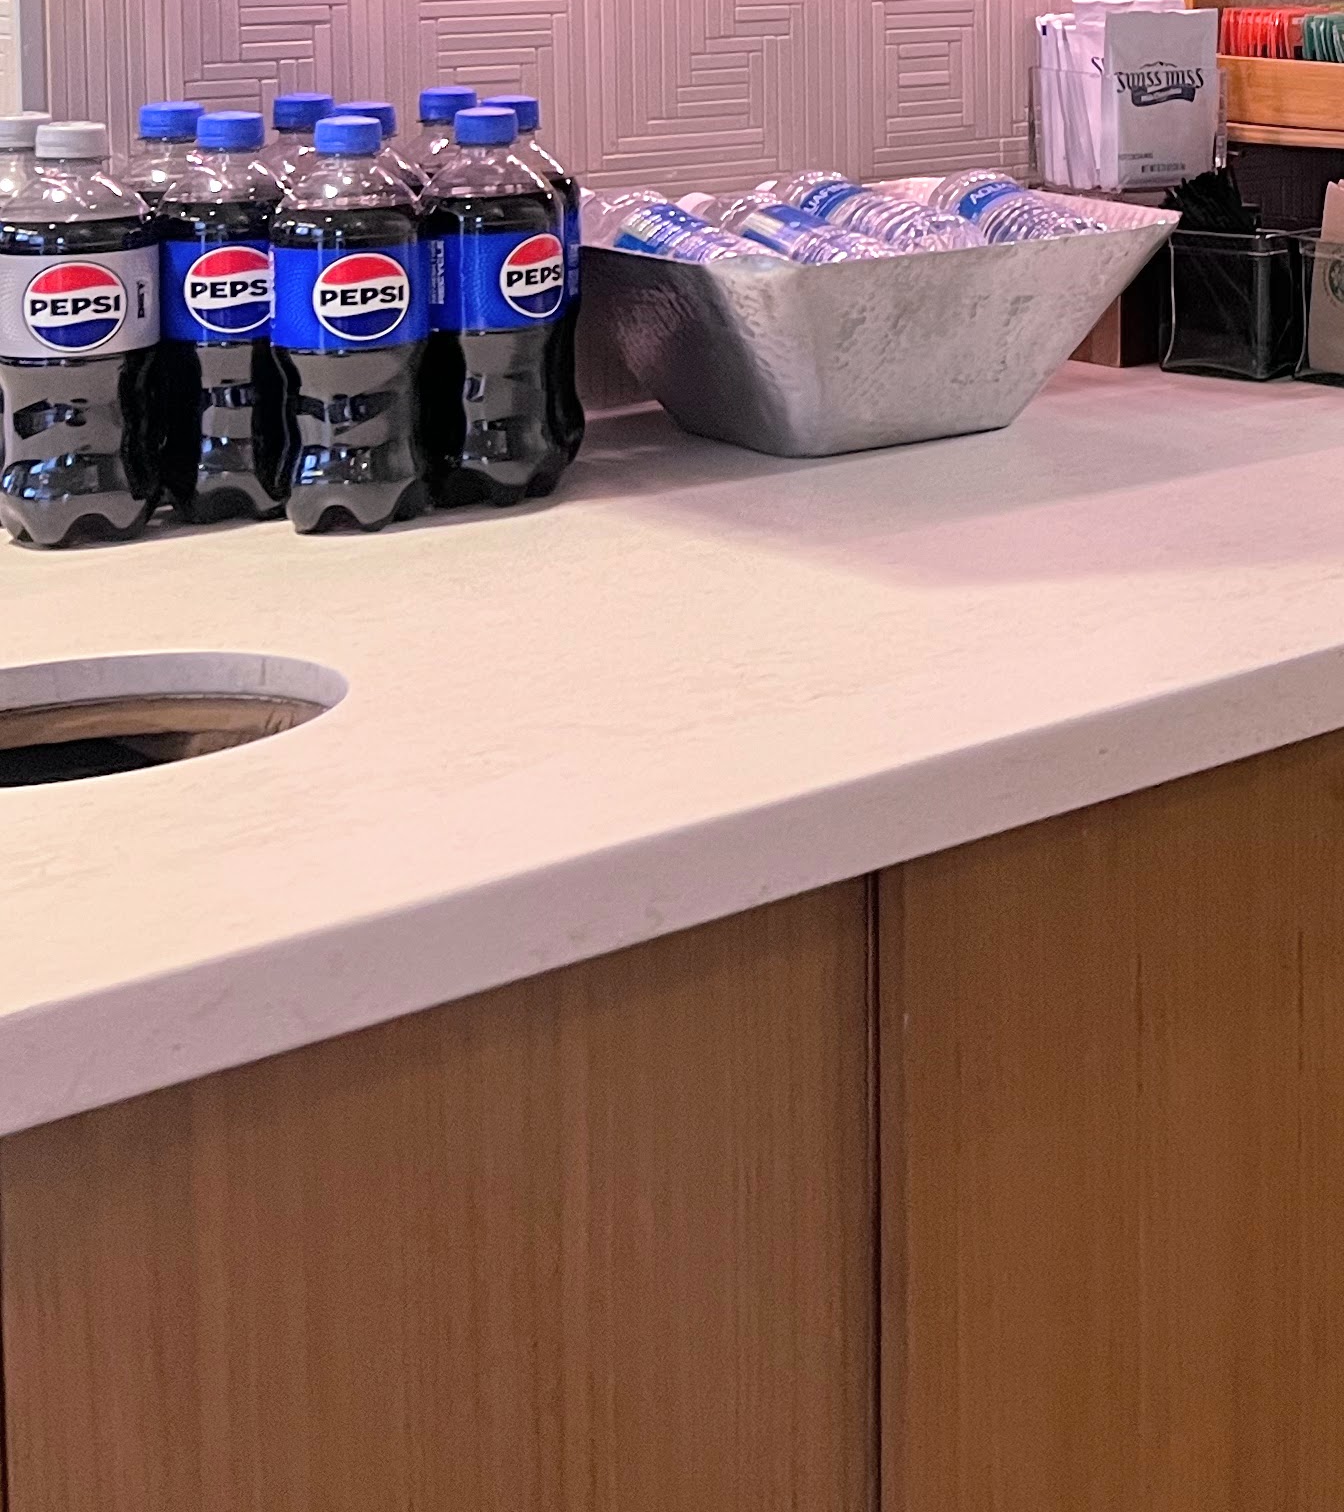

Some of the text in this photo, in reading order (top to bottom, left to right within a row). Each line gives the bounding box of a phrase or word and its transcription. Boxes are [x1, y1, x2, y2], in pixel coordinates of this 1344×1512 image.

[190, 279, 269, 298] PEPS
[320, 285, 405, 307] PEPSI
[30, 294, 121, 316] PEPSI
